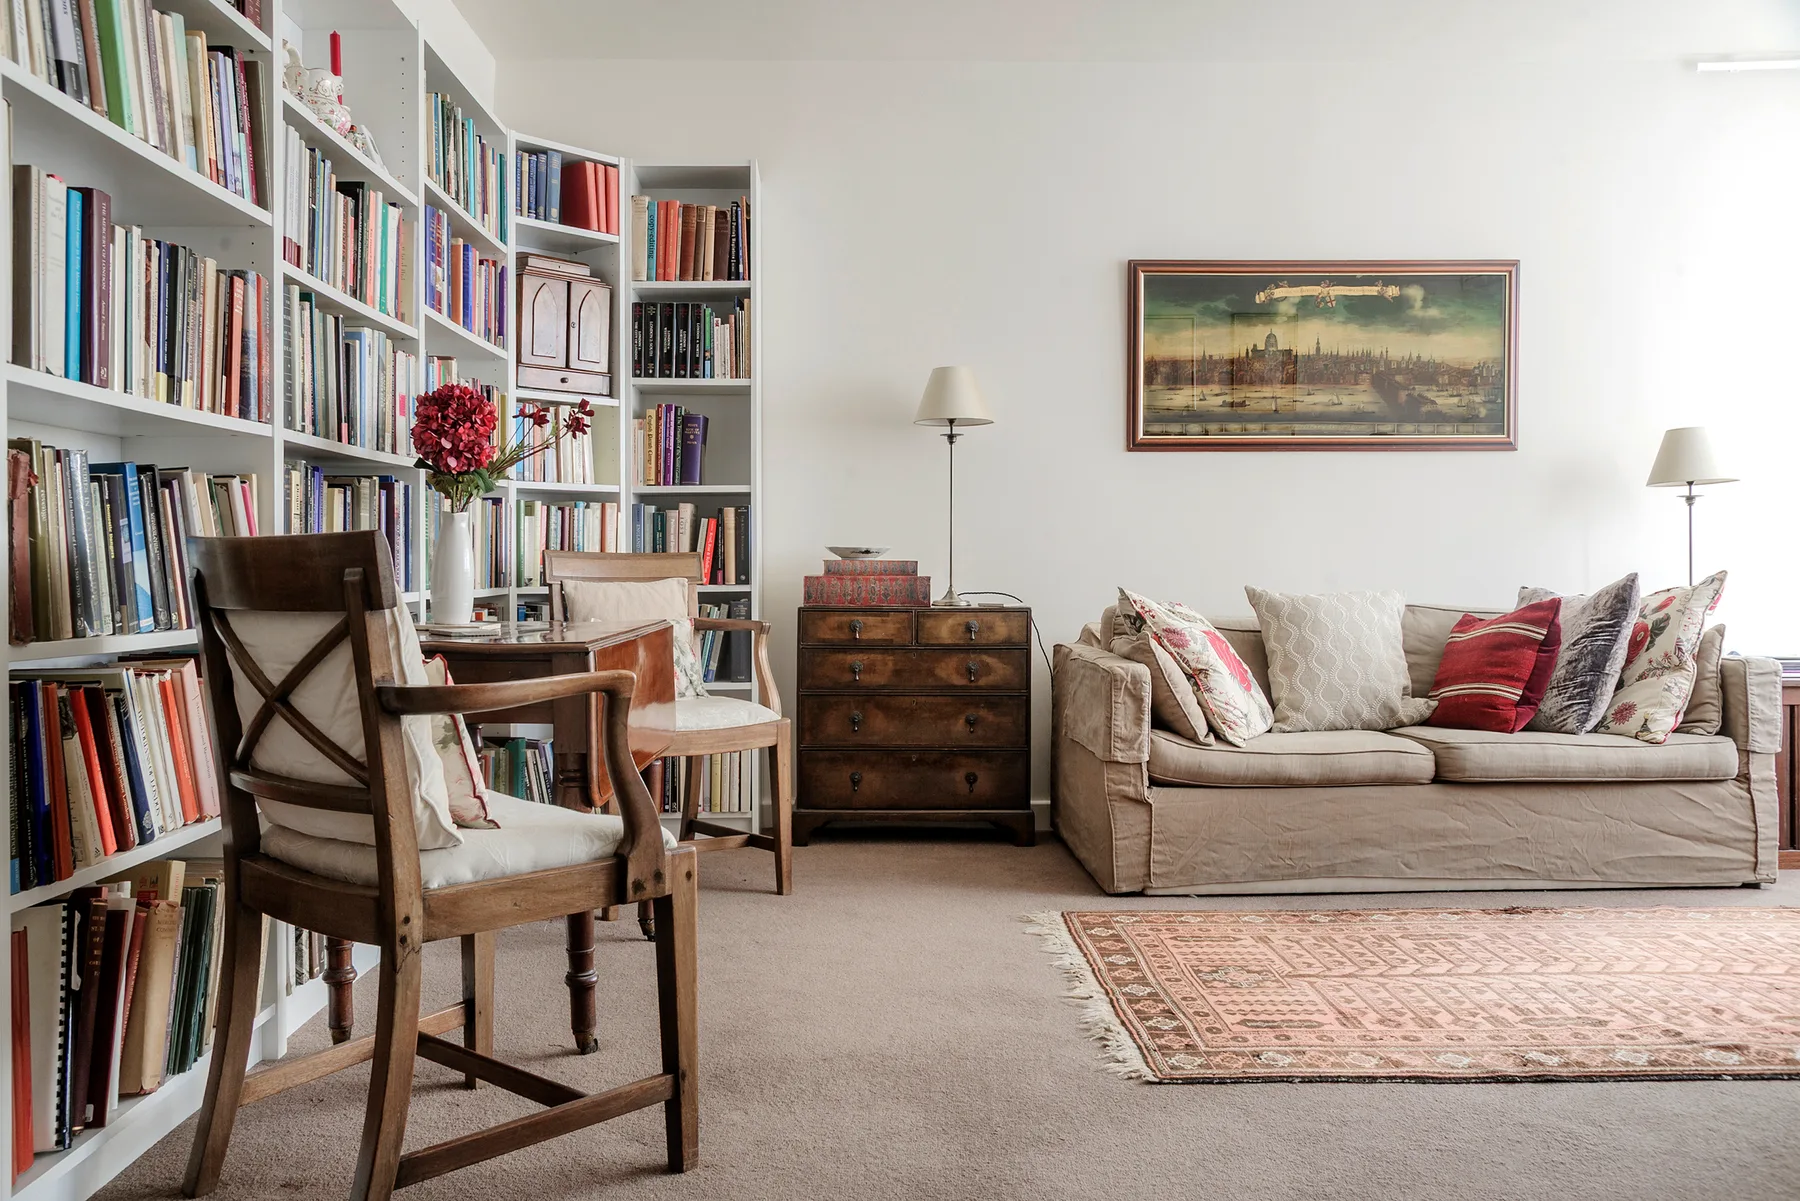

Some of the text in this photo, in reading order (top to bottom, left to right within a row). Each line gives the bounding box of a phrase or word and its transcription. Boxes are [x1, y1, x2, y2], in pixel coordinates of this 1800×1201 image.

[101, 249, 107, 259] OF
[648, 214, 656, 259] copy-editing
[82, 457, 90, 493] STUDIES
[85, 510, 94, 556] LONDON
[105, 504, 113, 533] Domestic
[150, 779, 161, 818] LONDON
